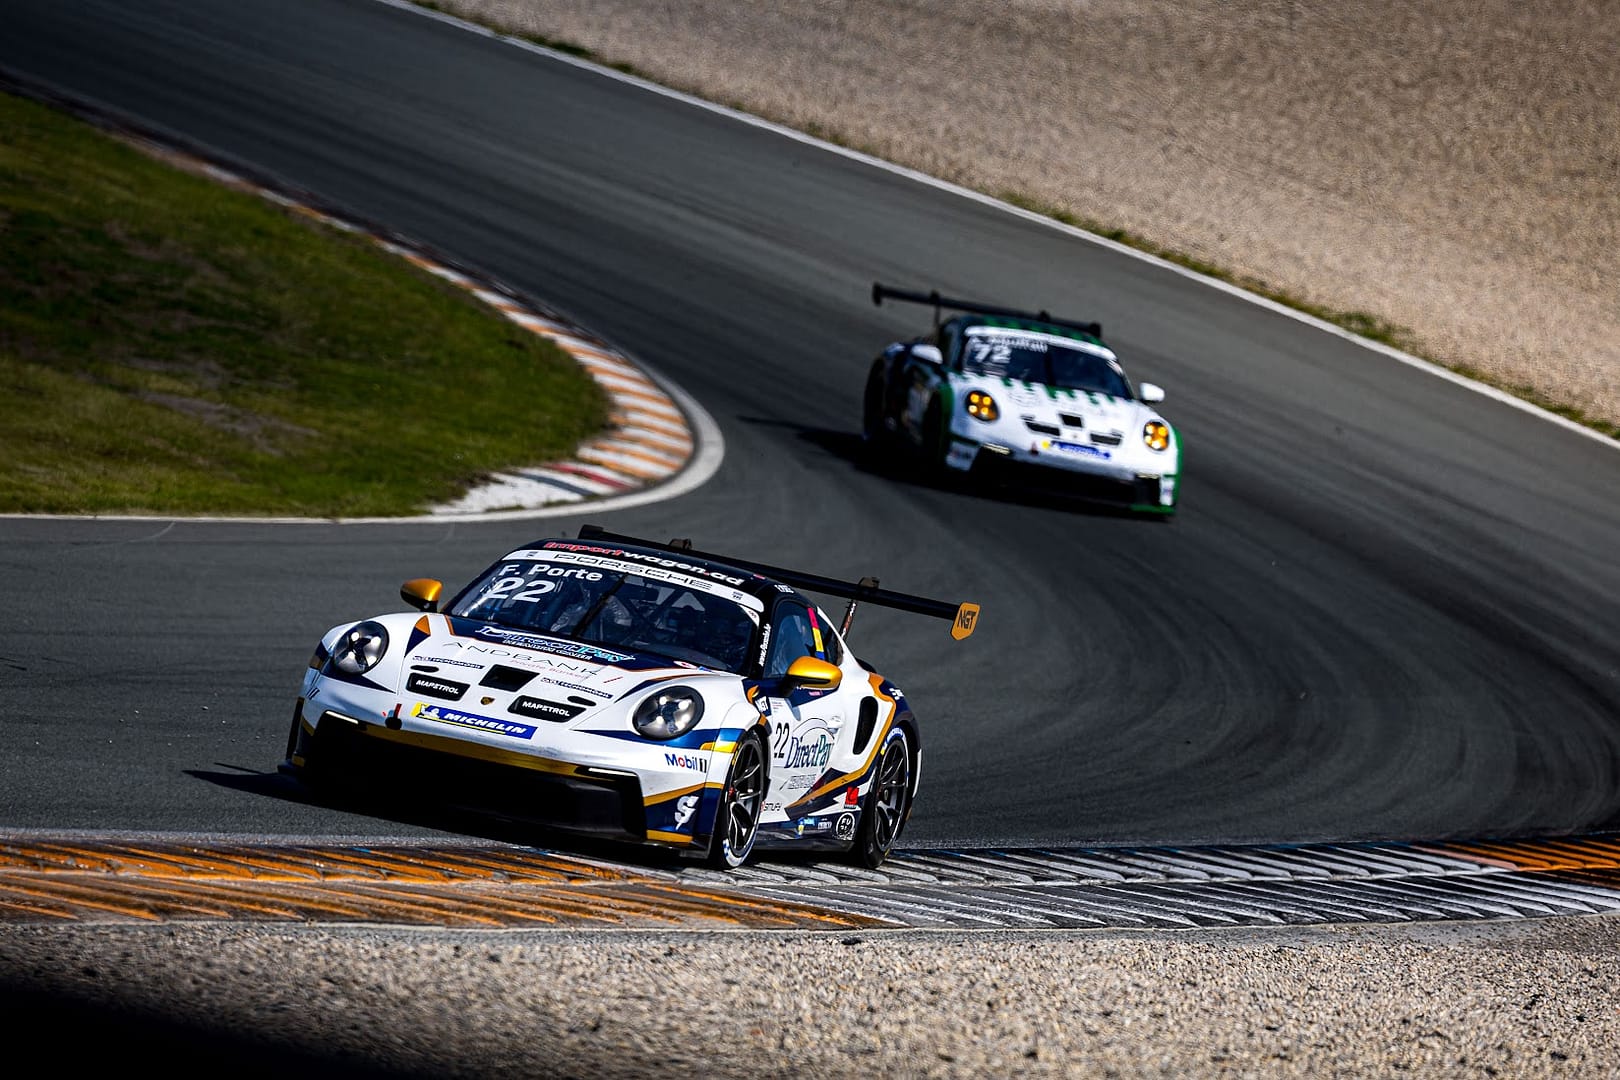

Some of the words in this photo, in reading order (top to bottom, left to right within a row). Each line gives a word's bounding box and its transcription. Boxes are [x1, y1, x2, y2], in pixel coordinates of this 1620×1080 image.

[974, 343, 1012, 364] 72
[498, 564, 521, 576] F.
[528, 564, 603, 581] Porte
[543, 541, 745, 586] importwagen.ad
[554, 553, 713, 590] PORSCHE
[486, 576, 556, 603] 22
[957, 609, 977, 630] NGT
[443, 642, 598, 676] ANDBANK
[415, 679, 459, 695] MAPETROL
[522, 701, 571, 717] MAPETROL
[443, 713, 527, 734] MICHELIN
[773, 722, 790, 759] 22
[664, 753, 698, 771] Mobil
[784, 734, 830, 773] DirectPay
